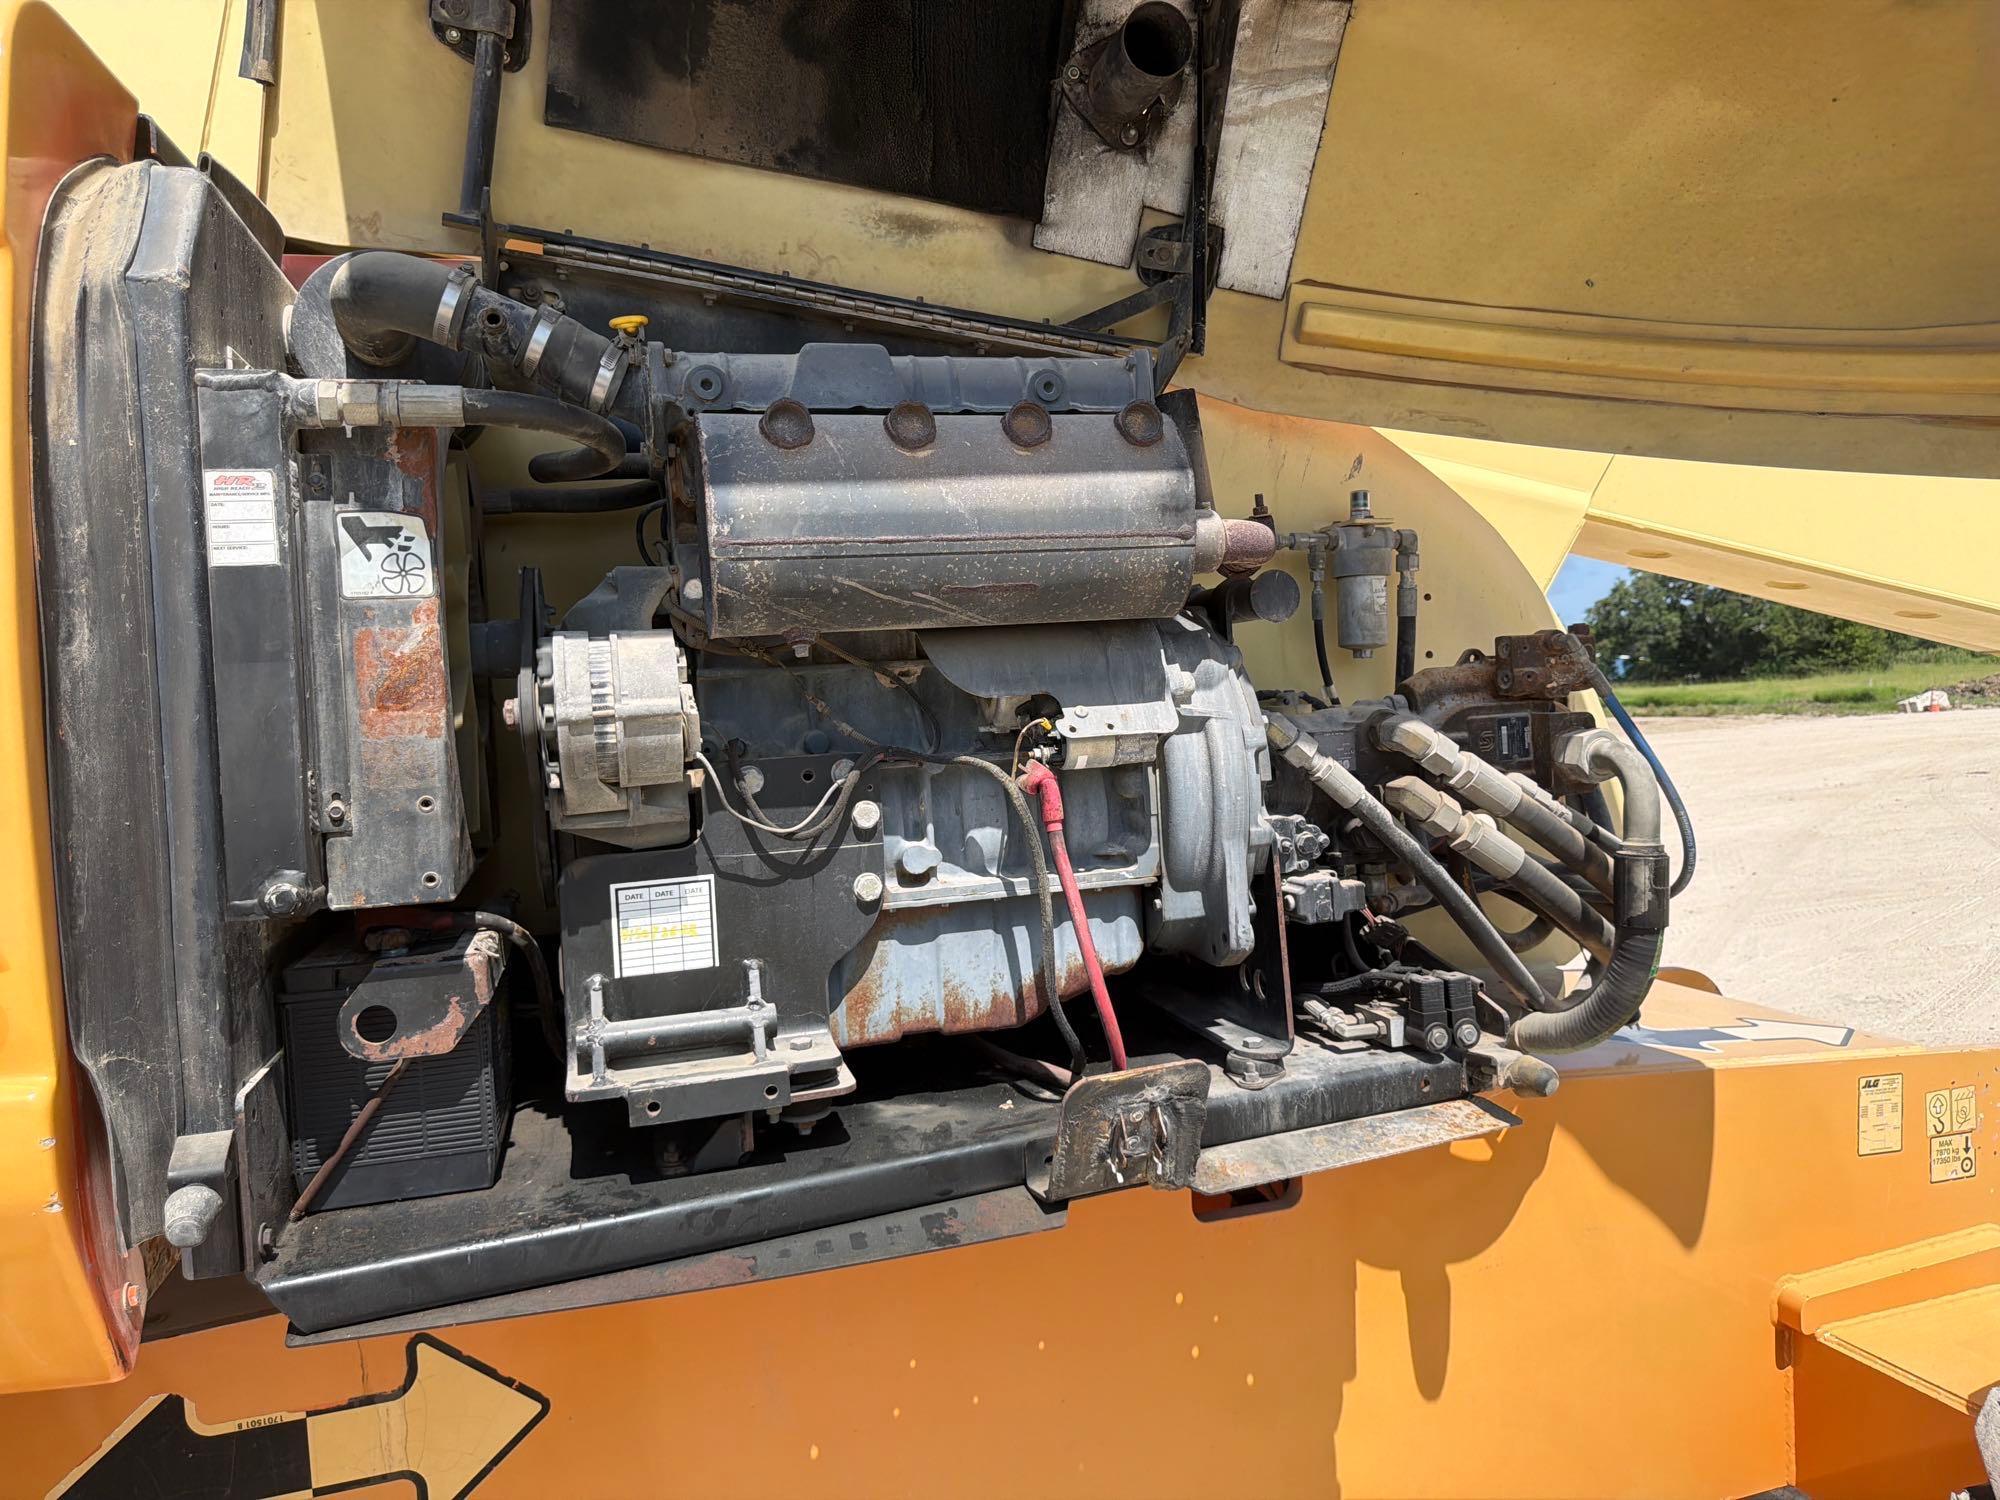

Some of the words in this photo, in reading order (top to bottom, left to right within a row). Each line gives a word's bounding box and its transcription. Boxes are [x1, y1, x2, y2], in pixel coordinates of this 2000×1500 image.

[625, 893, 644, 901] DATE
[655, 890, 674, 898] DATE
[1862, 1079, 1880, 1089] JLG
[1938, 1139, 1953, 1148] MAX
[1936, 1148, 1950, 1156] 7870
[1952, 1147, 1960, 1155] kg
[1933, 1157, 1951, 1165] 17350
[1952, 1155, 1961, 1163] lbs
[246, 1415, 284, 1428] 1701501
